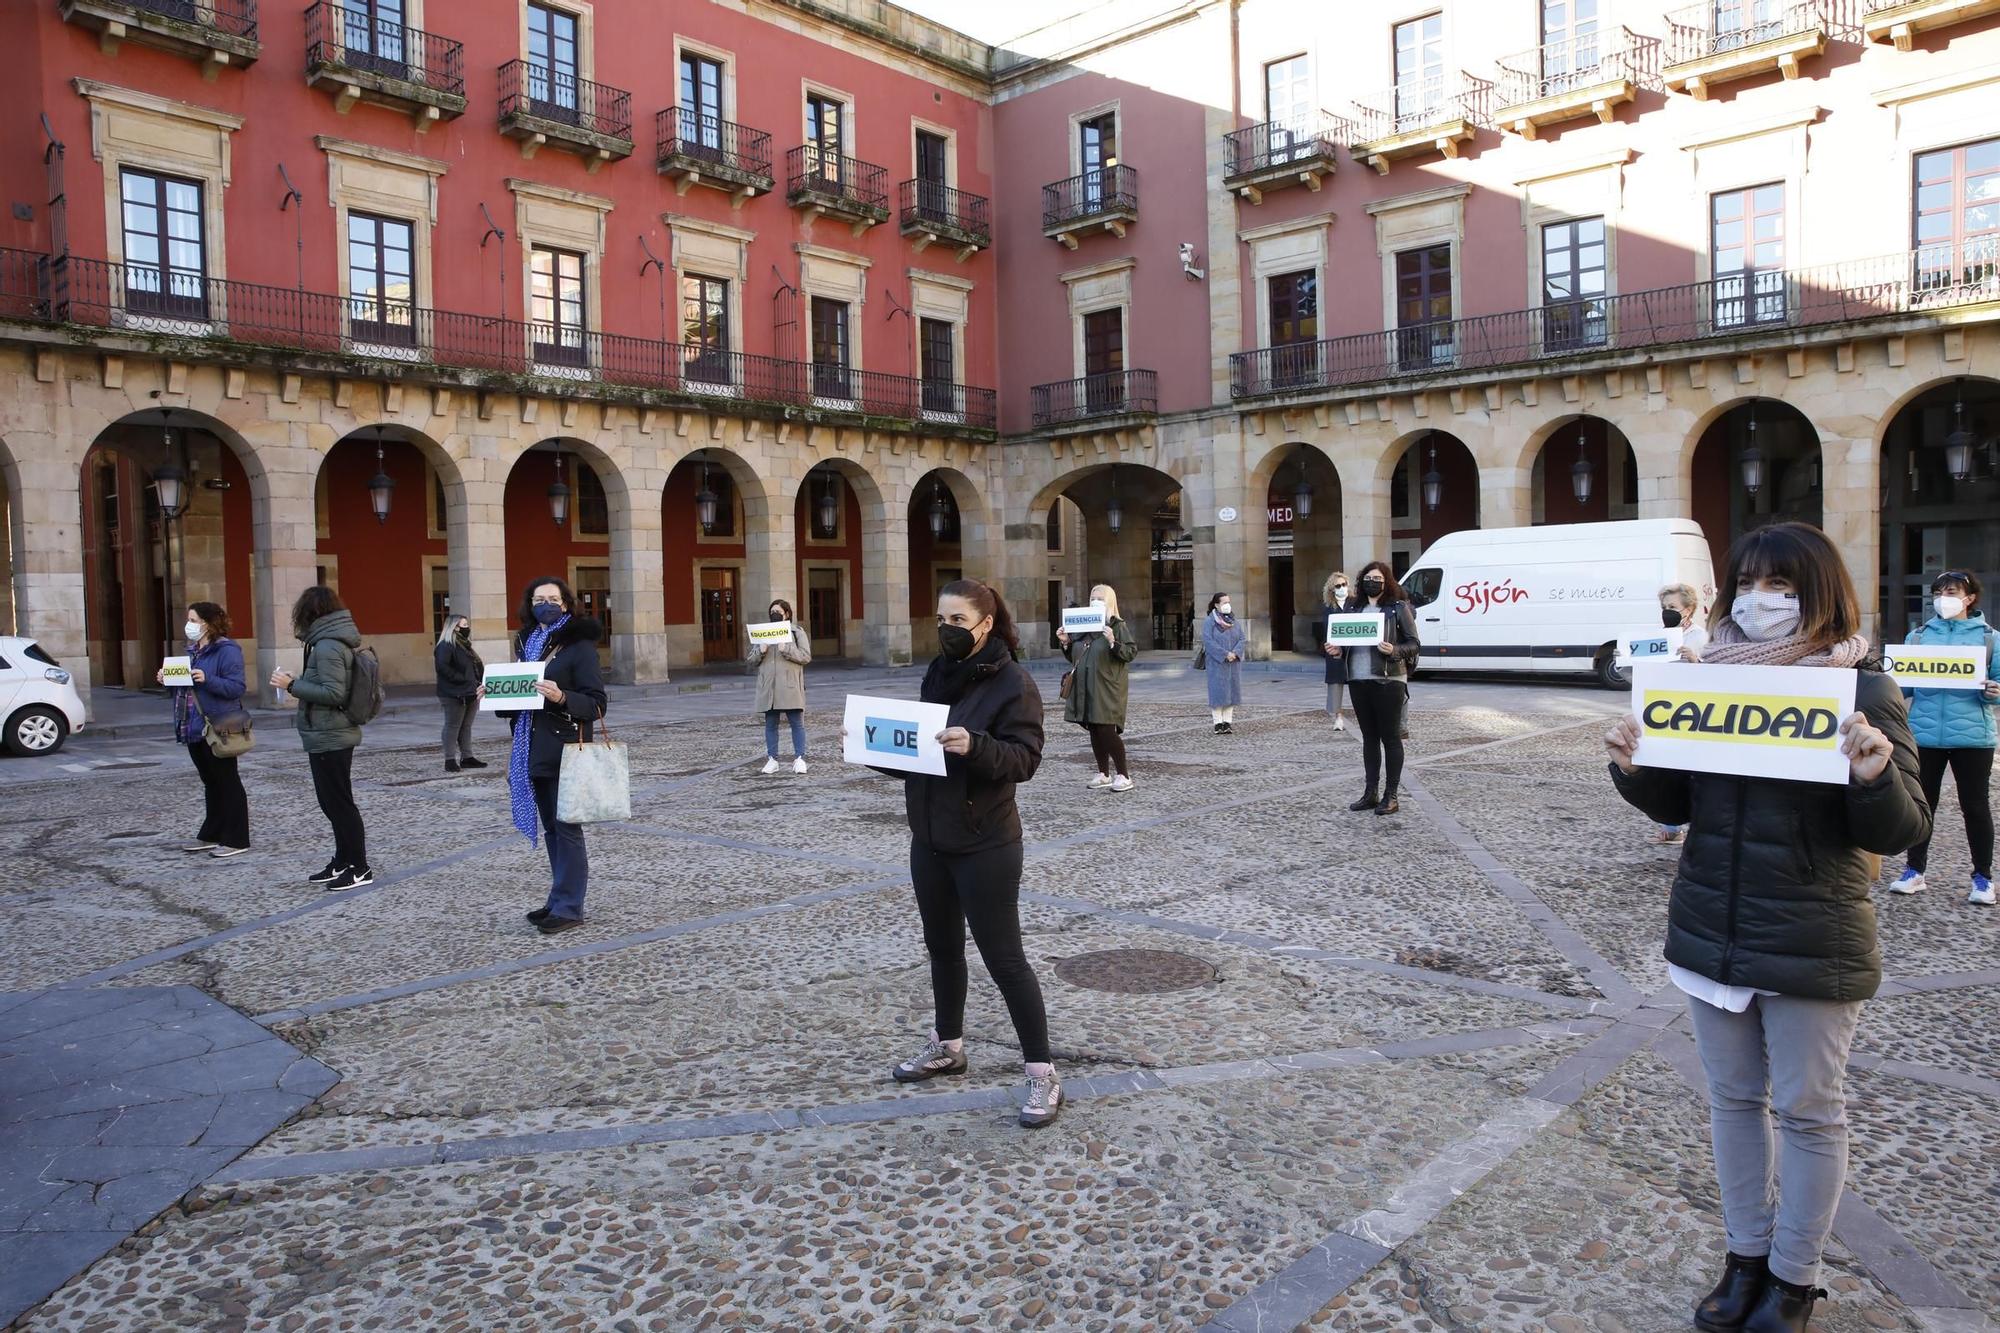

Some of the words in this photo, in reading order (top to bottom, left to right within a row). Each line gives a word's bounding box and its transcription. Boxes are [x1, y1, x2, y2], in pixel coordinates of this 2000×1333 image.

[1455, 578, 1529, 615] gijón
[1549, 587, 1565, 600] se
[1571, 585, 1625, 599] mueve
[1065, 616, 1102, 624] PRESENCIAL
[1331, 626, 1377, 635] SEGURA
[1630, 644, 1639, 655] Y
[1649, 641, 1668, 653] DE
[1893, 661, 1975, 674] CALIDAD
[1643, 700, 1839, 740] CALIDAD
[865, 725, 877, 743] Y
[893, 728, 918, 750] DE
